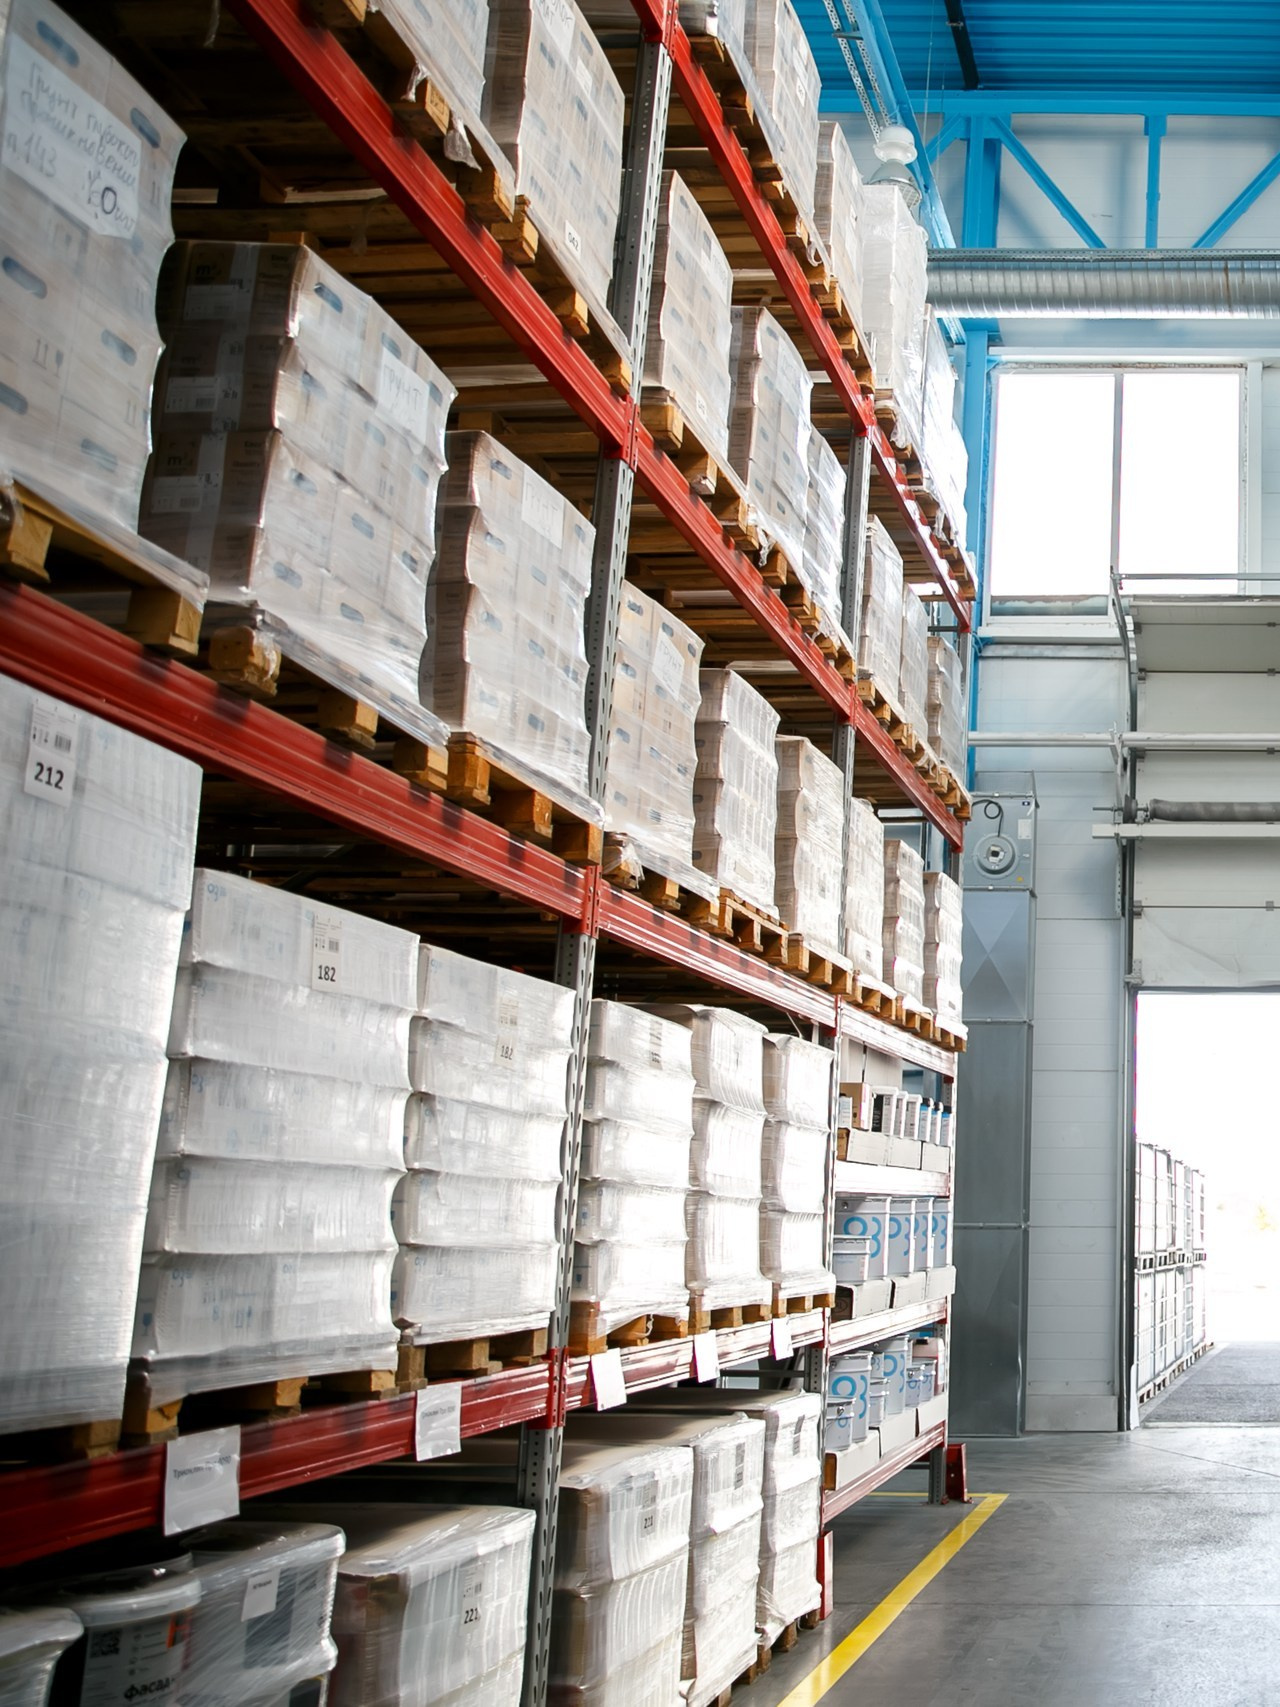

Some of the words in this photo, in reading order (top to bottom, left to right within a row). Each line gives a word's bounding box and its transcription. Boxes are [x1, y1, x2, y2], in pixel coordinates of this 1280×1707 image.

[34, 761, 64, 790] 212
[318, 965, 336, 982] 182
[500, 1045, 514, 1060] 182
